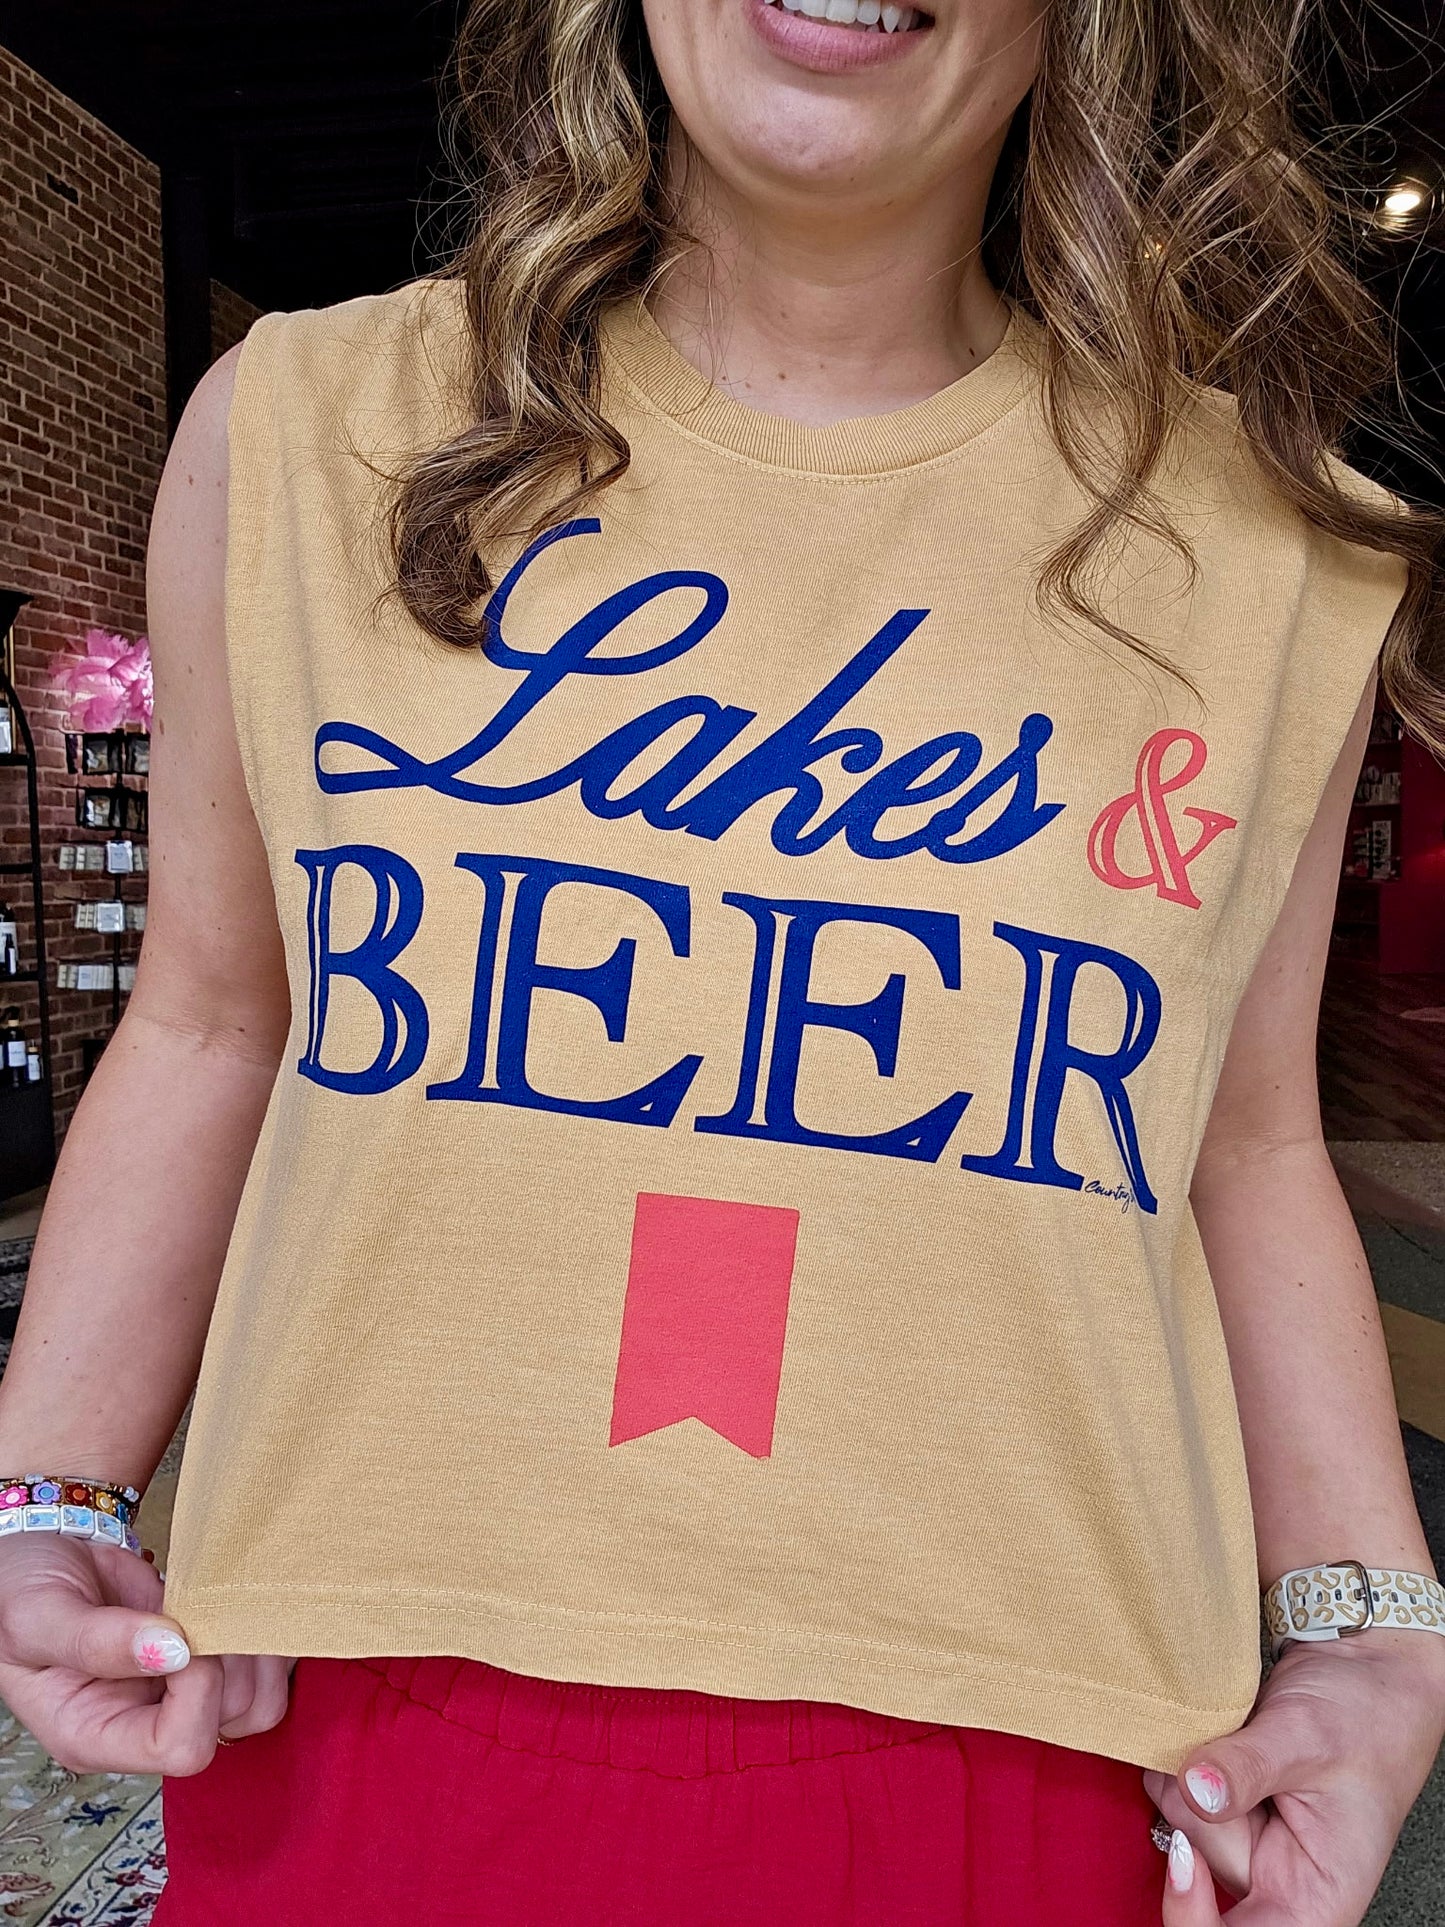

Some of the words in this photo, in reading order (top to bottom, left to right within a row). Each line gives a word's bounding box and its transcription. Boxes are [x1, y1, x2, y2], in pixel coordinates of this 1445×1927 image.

[315, 518, 1065, 864] Lakes
[1087, 728, 1237, 910] &
[295, 844, 1162, 1215] BEER
